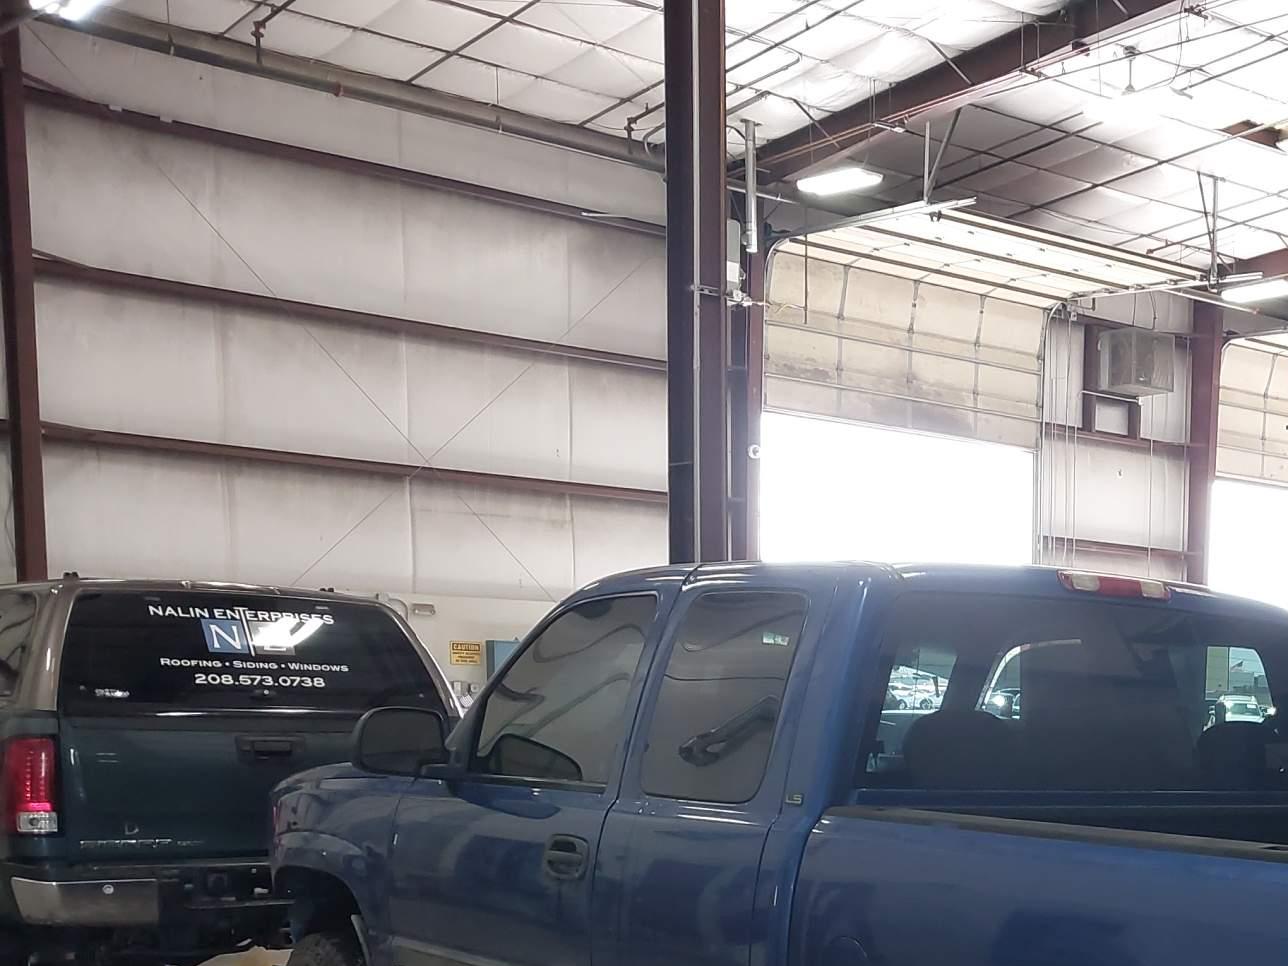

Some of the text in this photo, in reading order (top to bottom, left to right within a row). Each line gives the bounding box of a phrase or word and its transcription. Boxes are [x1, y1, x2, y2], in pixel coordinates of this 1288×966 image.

[148, 605, 210, 620] NALIN
[194, 673, 326, 688] 208.573.0738
[785, 794, 803, 805] LS
